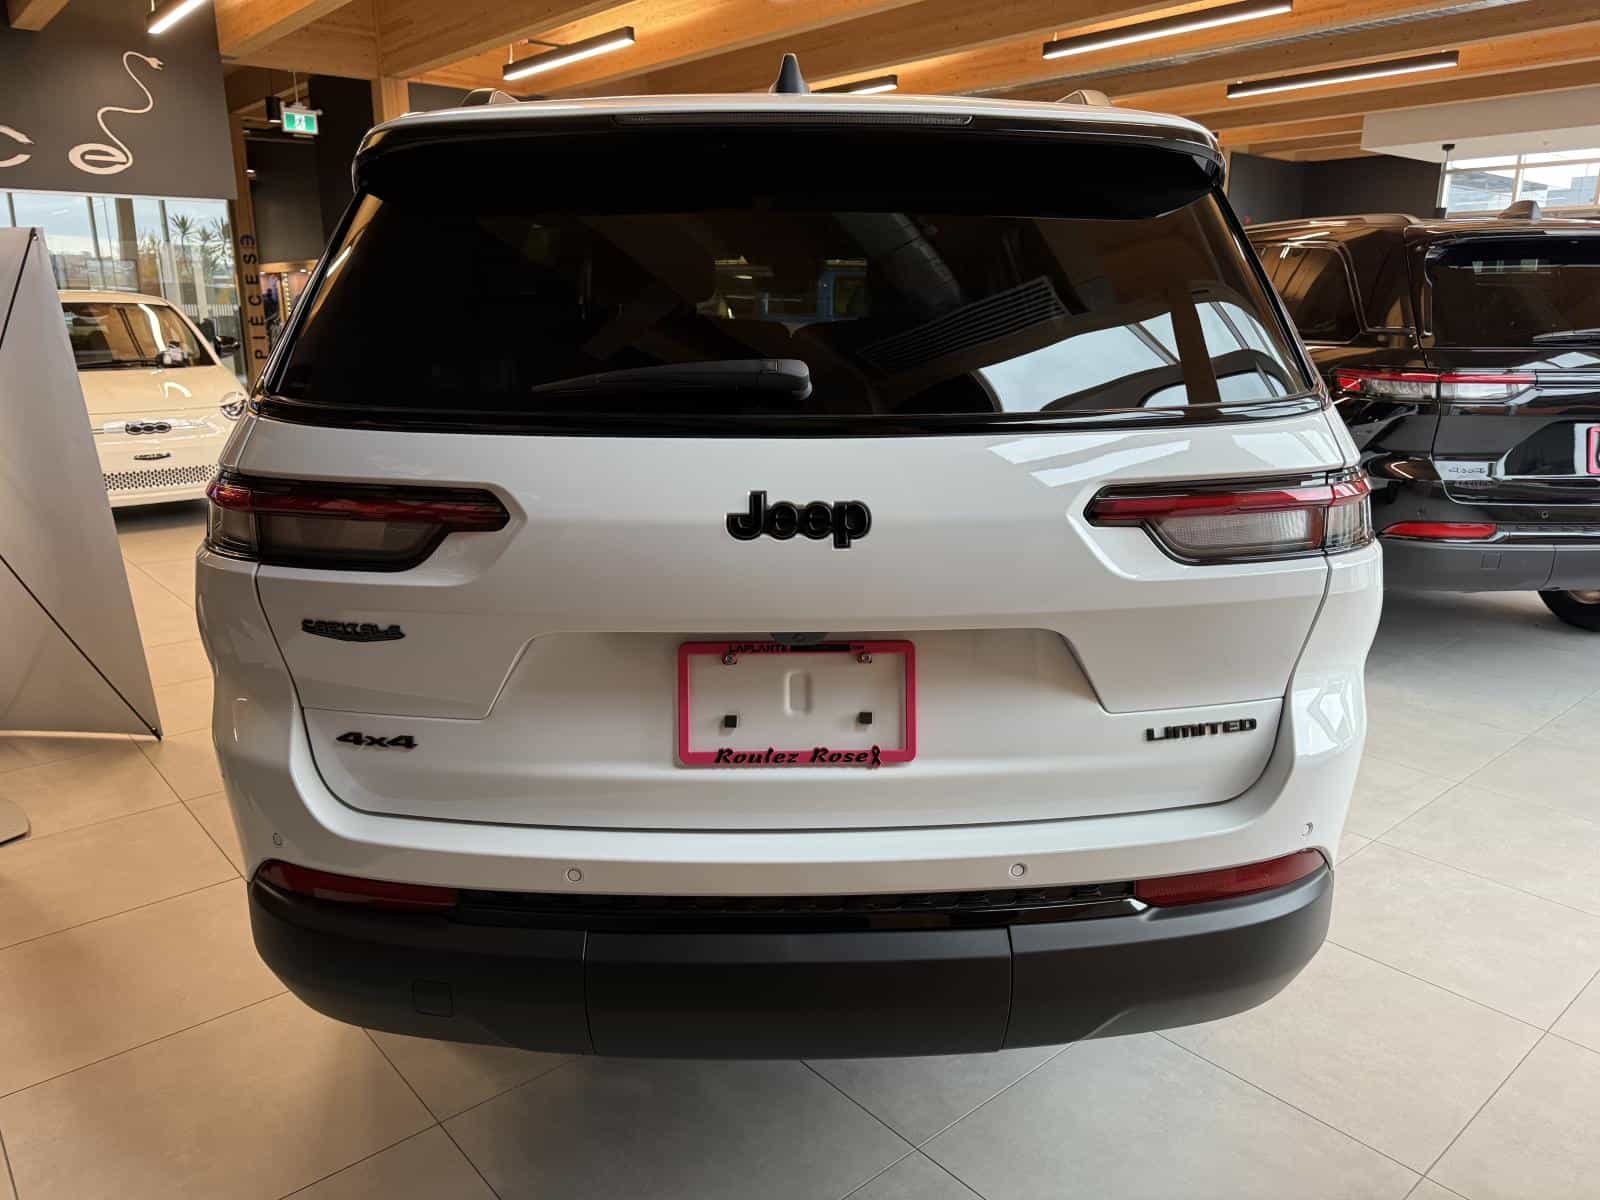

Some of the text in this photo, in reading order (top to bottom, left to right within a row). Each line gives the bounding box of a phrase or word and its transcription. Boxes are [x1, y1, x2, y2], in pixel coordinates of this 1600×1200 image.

[726, 490, 872, 549] Jeep
[1146, 718, 1257, 741] LIMITED
[336, 731, 418, 749] 4x4
[714, 747, 868, 765] Roulez Rose
